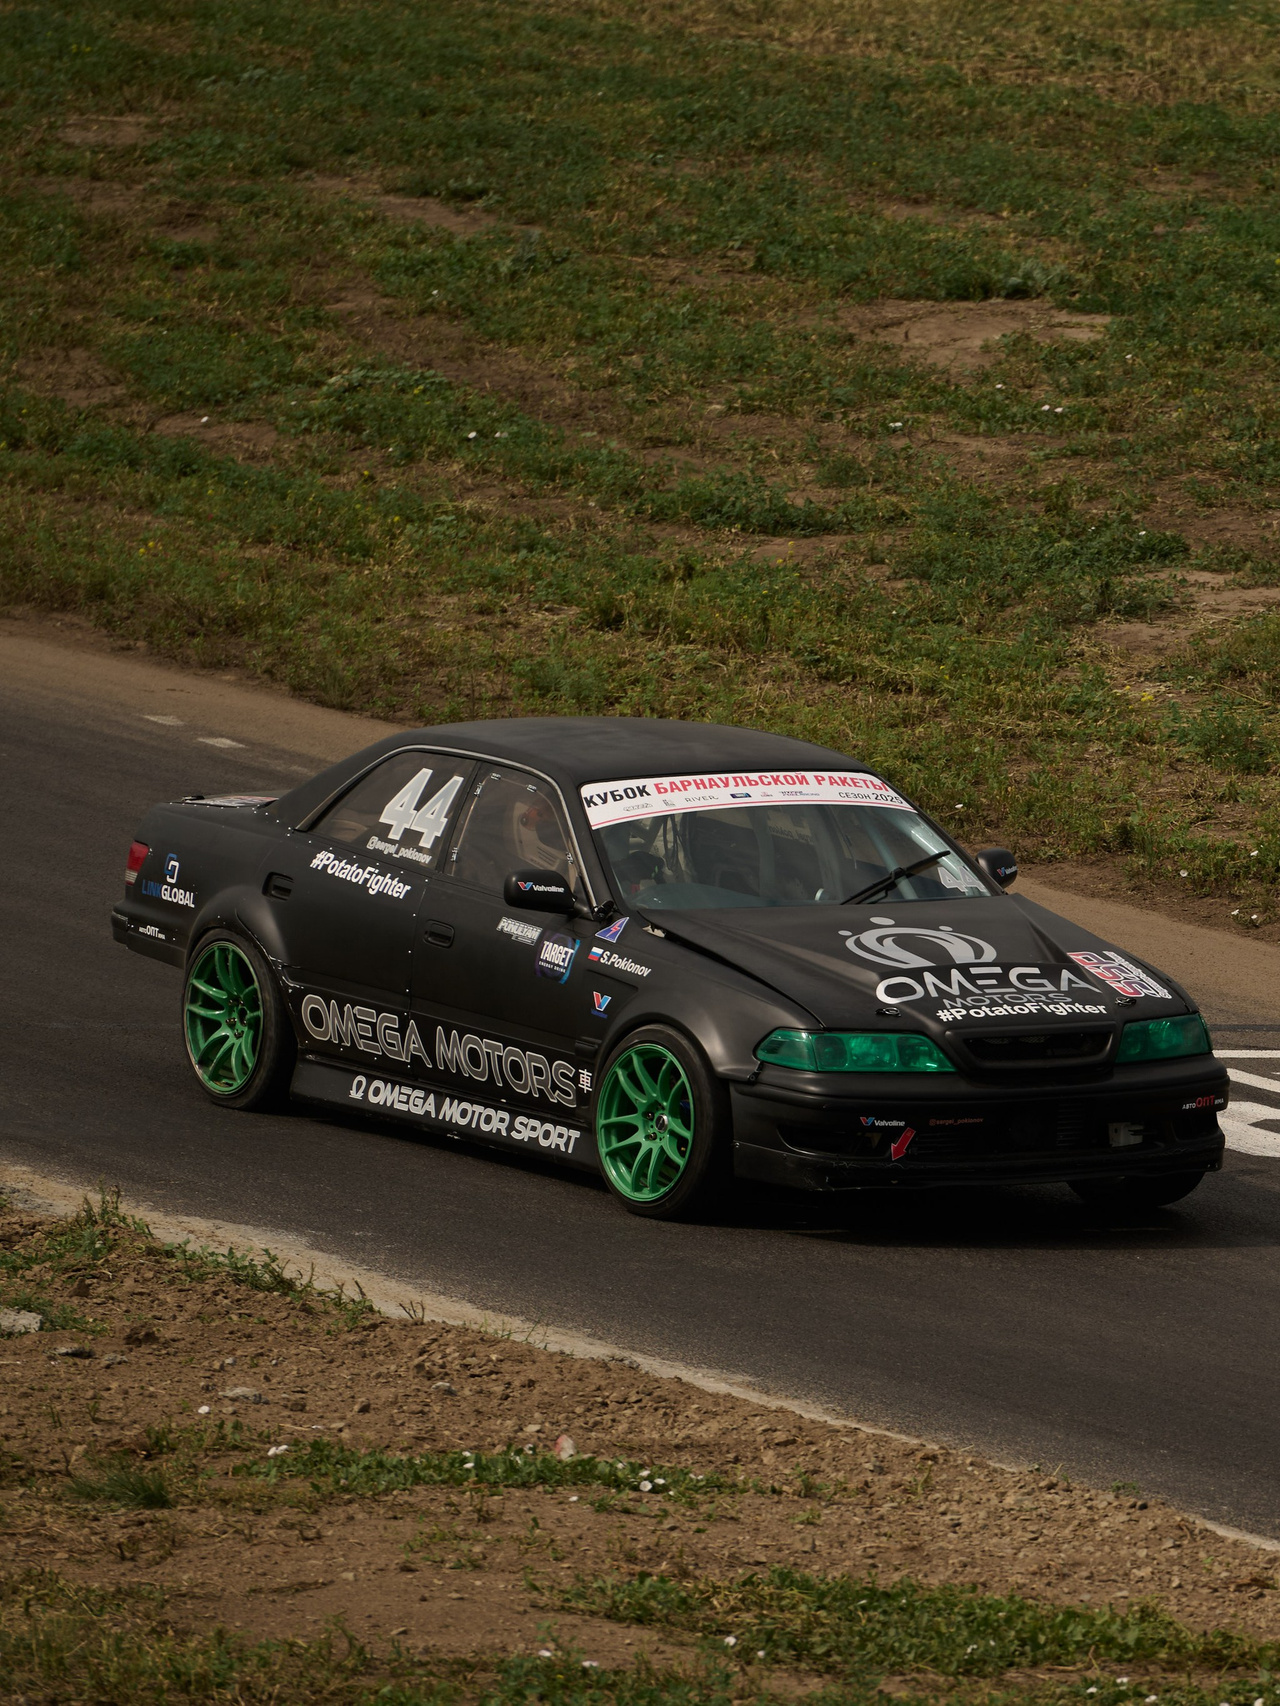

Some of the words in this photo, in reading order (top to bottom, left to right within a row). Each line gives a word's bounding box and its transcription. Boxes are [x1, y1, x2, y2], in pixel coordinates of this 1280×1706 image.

[583, 785, 652, 808] КУБОК
[653, 773, 810, 794] БАРНАУЛЬСКОЙ
[814, 775, 889, 792] РАКЕТЫ
[838, 792, 871, 800] СЕЗОН
[872, 793, 903, 804] 2025
[379, 767, 464, 848] 44
[310, 850, 411, 899] #PotatoFighter
[937, 866, 988, 892] 44
[142, 880, 195, 908] LINKGLOBAL
[533, 885, 565, 893] Valvoline
[540, 941, 575, 967] TARGET
[600, 951, 651, 977] S.Poklonov
[876, 966, 1102, 1004] OMEGA
[936, 1002, 1107, 1023] #PotatoFighter
[942, 993, 1073, 1009] MOTORS
[301, 994, 432, 1068] OMEGA
[436, 1025, 577, 1107] MOTORS
[368, 1080, 435, 1118] OMEGA
[439, 1098, 510, 1136] MOTOR
[511, 1116, 580, 1153] SPORT
